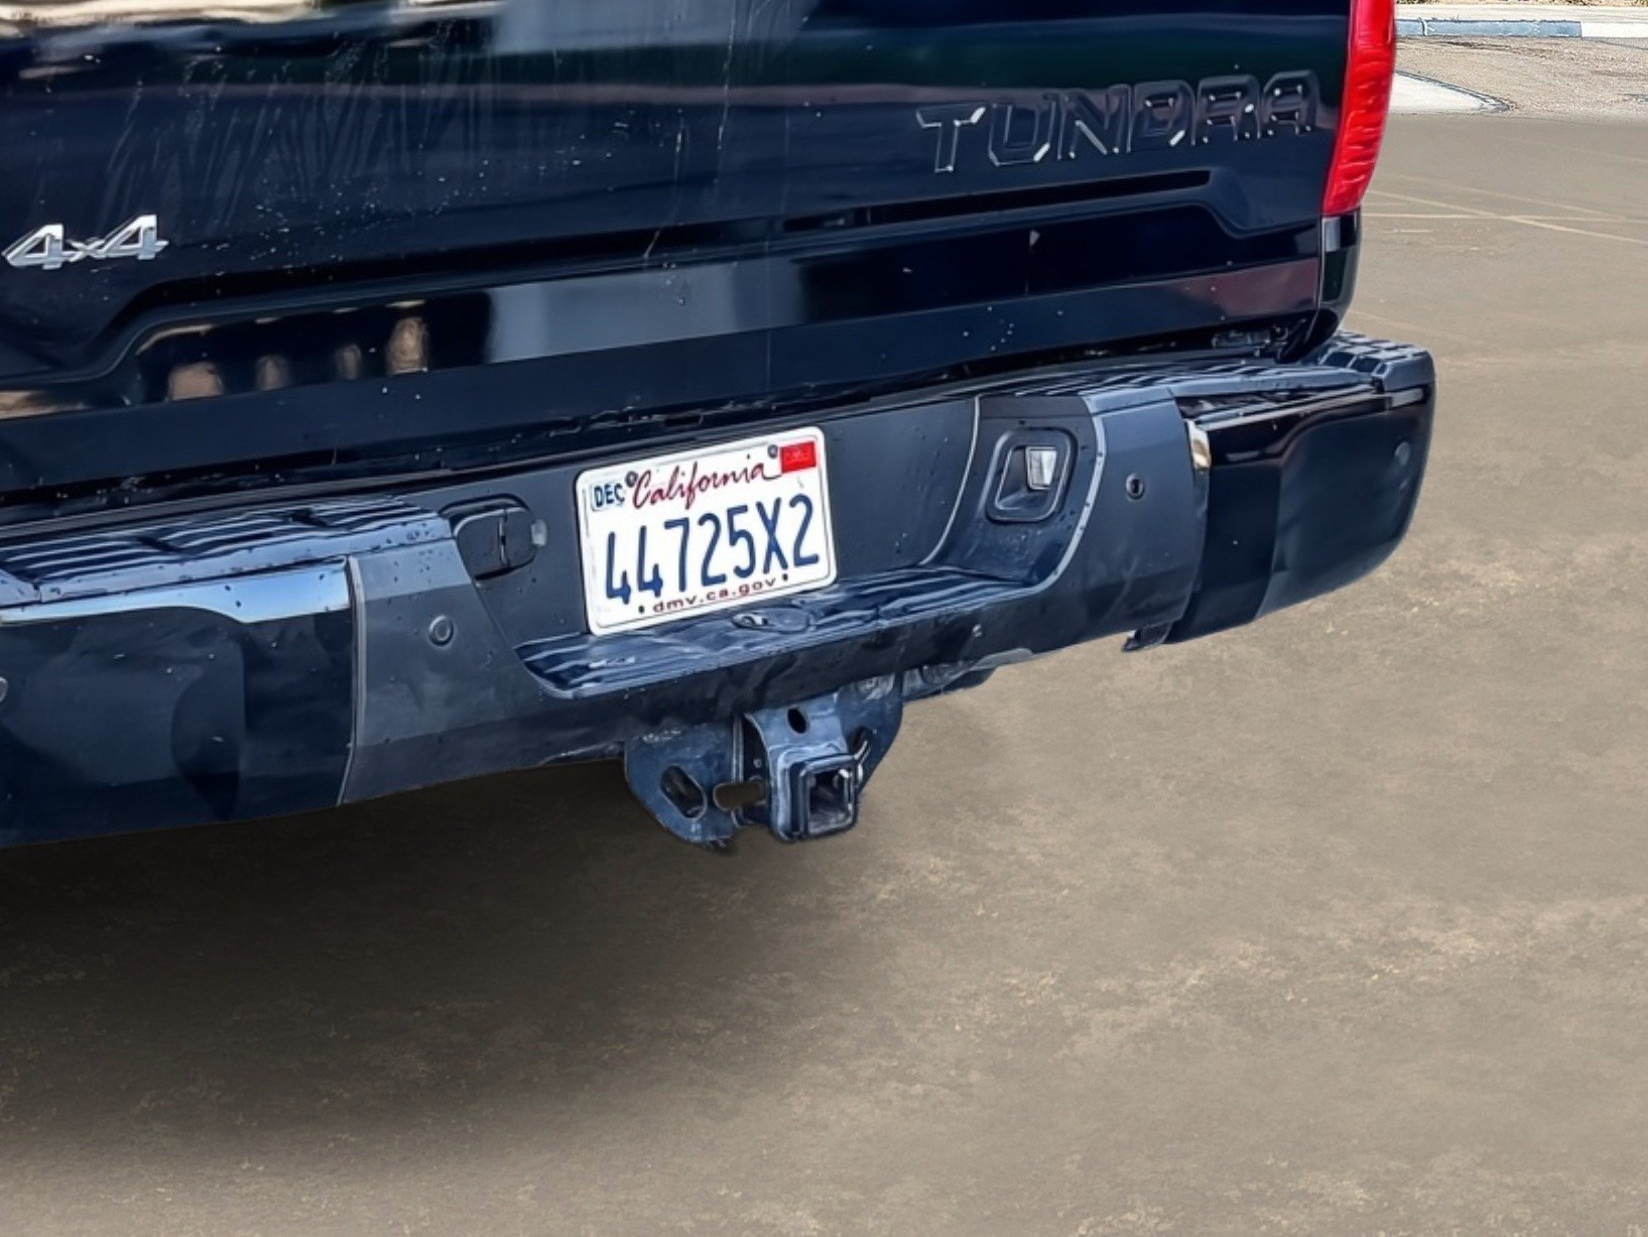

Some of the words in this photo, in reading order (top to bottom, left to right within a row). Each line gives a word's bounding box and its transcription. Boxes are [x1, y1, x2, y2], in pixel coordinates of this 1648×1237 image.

[915, 69, 1320, 173] TUNDRA
[593, 482, 625, 508] DEC
[632, 460, 783, 510] California
[605, 493, 820, 605] 44725X2
[653, 577, 777, 613] dmv.ca.gov
